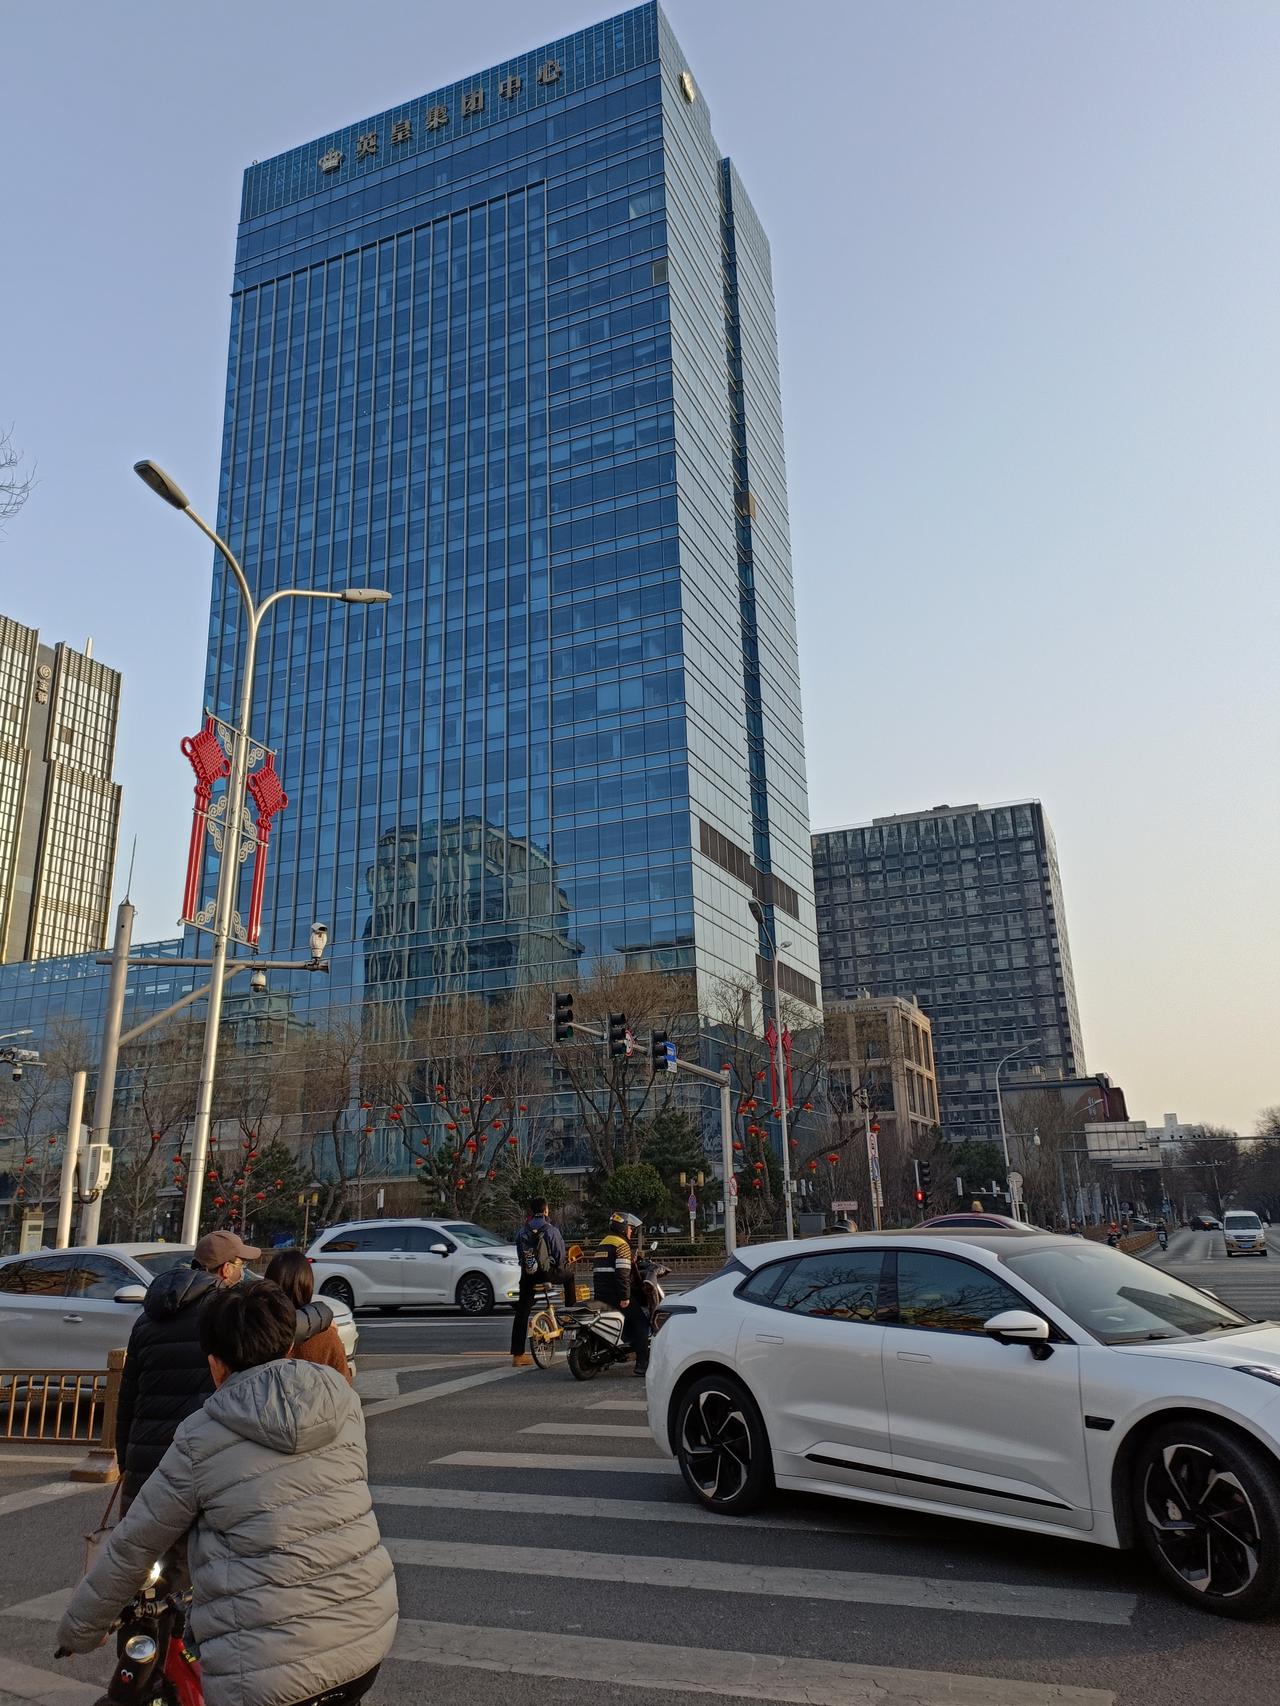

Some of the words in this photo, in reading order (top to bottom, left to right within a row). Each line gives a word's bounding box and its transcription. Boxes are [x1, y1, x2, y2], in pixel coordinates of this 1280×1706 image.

[355, 60, 561, 159] 英皇集团中心
